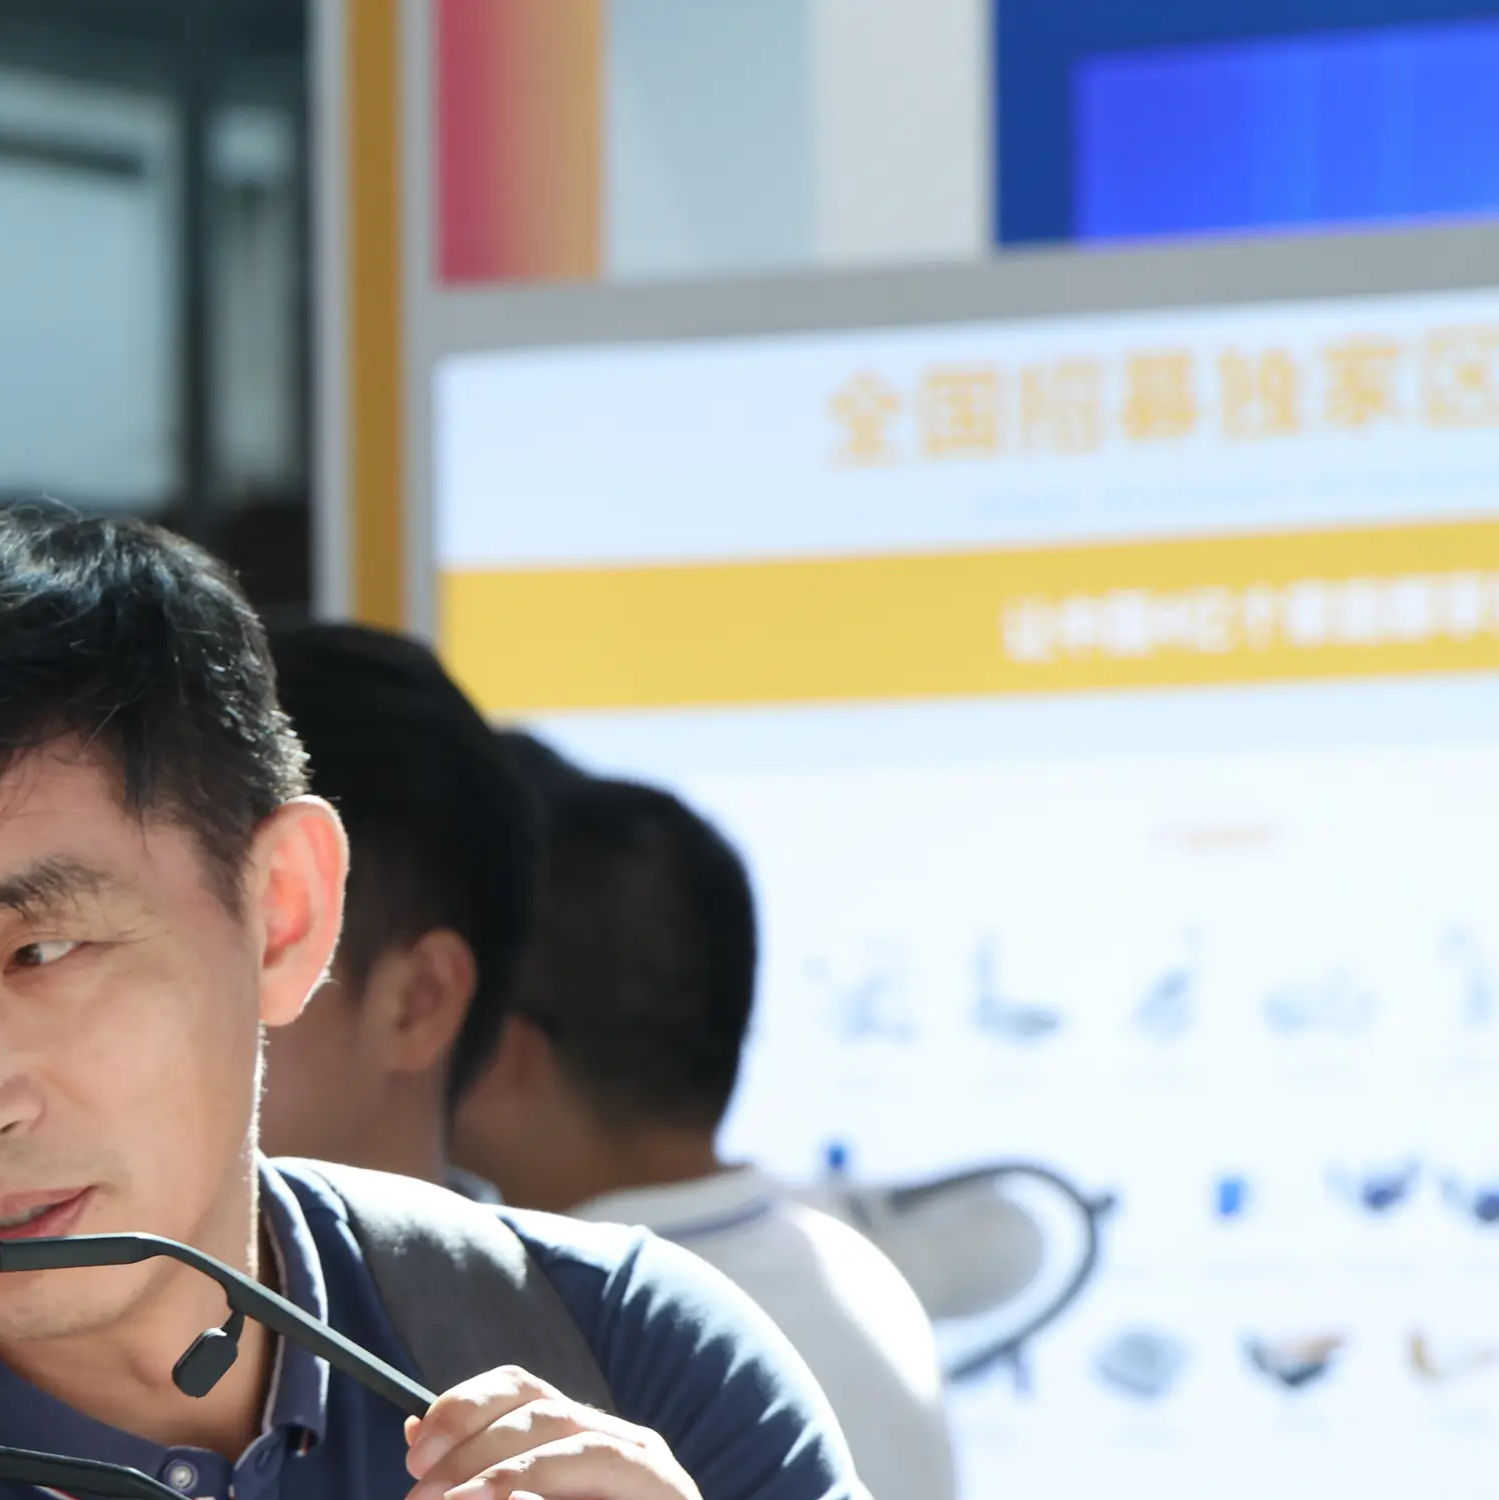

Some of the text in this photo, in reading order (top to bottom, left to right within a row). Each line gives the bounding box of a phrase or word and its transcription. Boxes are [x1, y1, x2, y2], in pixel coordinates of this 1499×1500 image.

[827, 325, 1499, 468] 全国招募独家区
